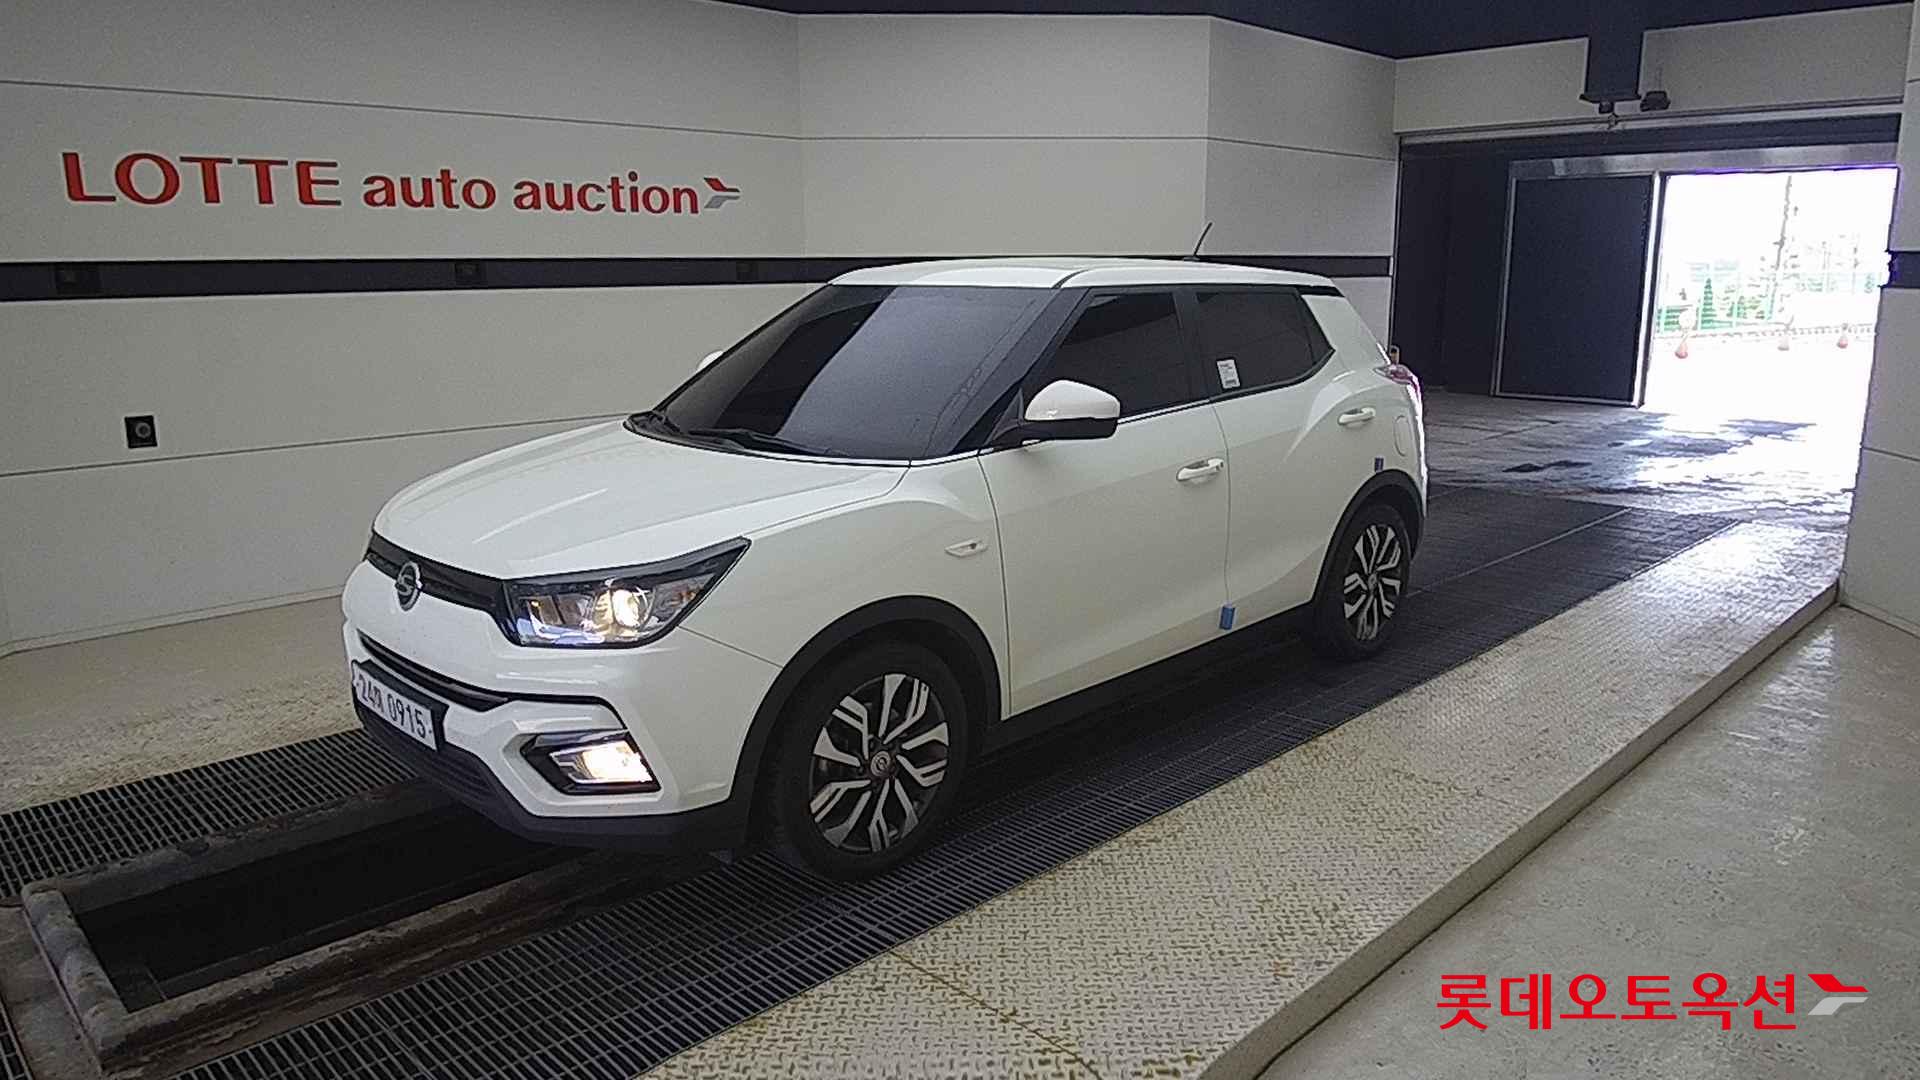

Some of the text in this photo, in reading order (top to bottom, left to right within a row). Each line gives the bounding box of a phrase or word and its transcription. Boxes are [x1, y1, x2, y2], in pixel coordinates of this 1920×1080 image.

[62, 152, 699, 215] LOTTE auto auction
[387, 693, 426, 739] 0915
